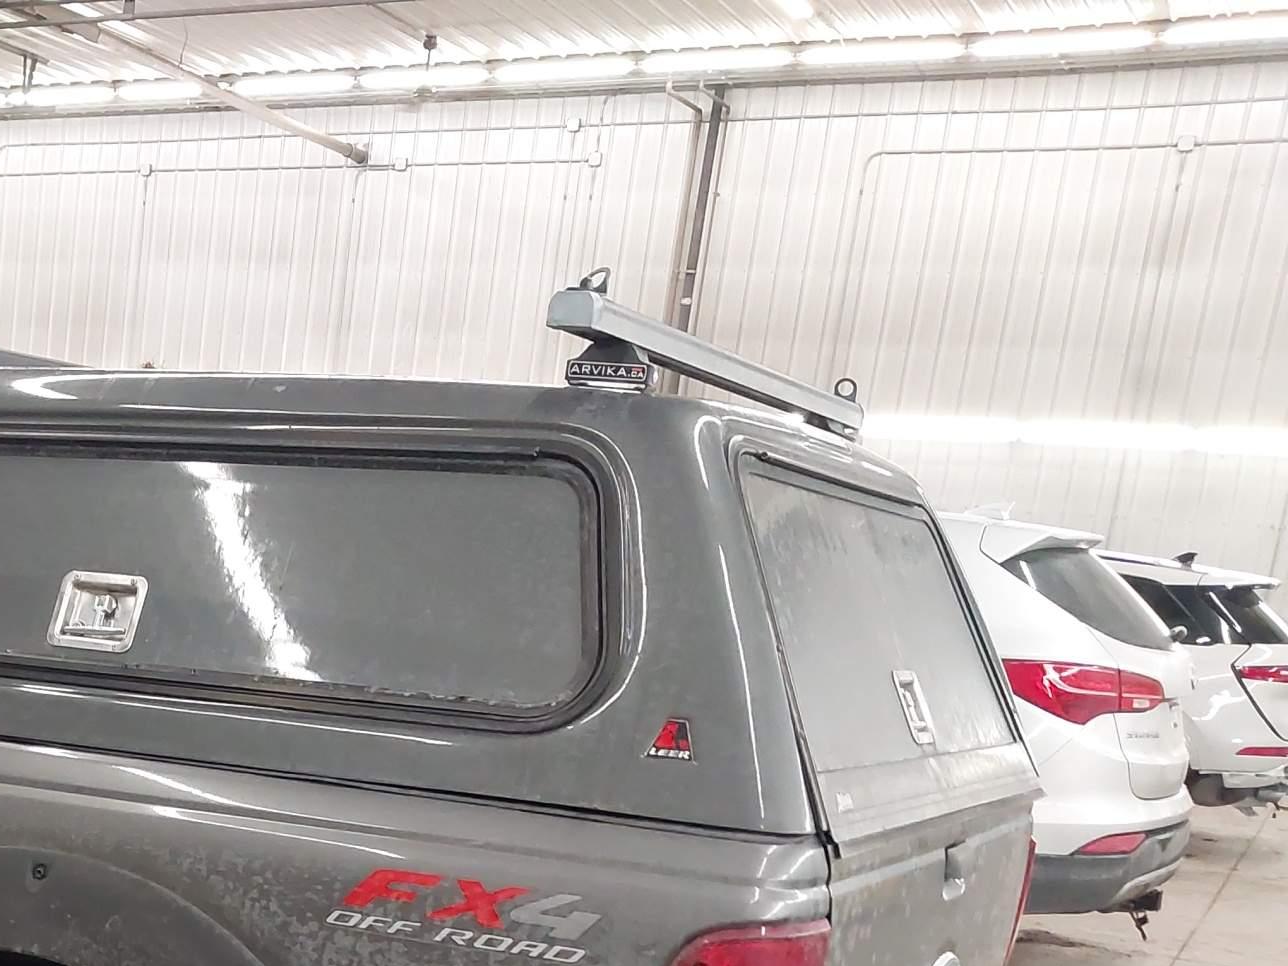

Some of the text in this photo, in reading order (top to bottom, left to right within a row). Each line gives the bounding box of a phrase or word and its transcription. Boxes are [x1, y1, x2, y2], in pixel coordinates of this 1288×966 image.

[648, 746, 691, 760] LEER
[343, 868, 602, 941] FX4
[325, 909, 587, 964] OFF ROAD
